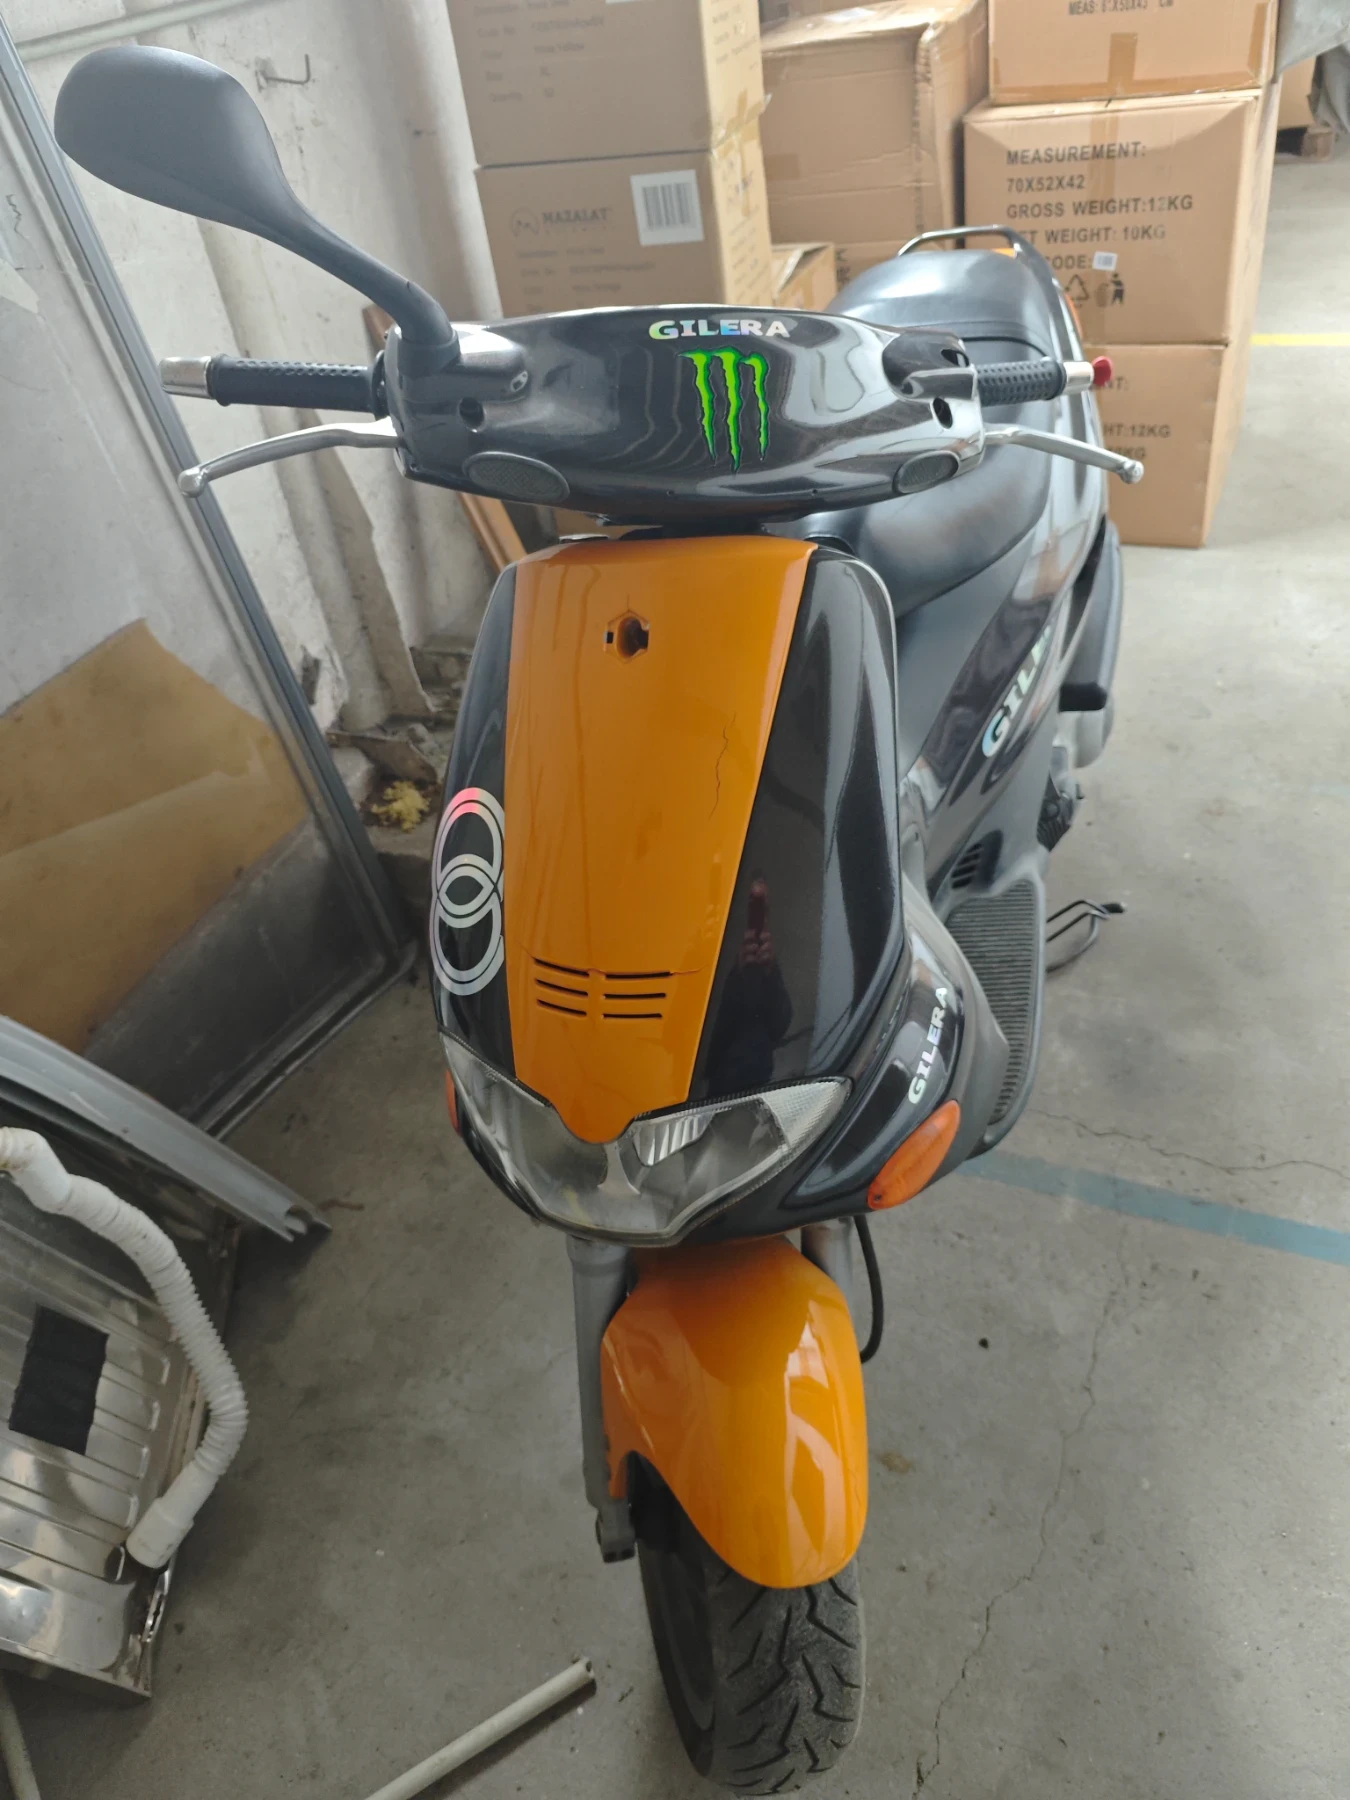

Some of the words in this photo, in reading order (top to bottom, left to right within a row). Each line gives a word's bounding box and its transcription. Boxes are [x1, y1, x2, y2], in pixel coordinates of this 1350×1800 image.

[1007, 141, 1147, 165] MEASUREMENT:
[1007, 174, 1086, 193] 70X52X42
[1007, 203, 1065, 219] GROSS
[1045, 227, 1118, 244] WEIGHT:
[1123, 224, 1166, 240] 10KG
[649, 319, 790, 340] GILERA
[908, 987, 948, 1104] GILERA
